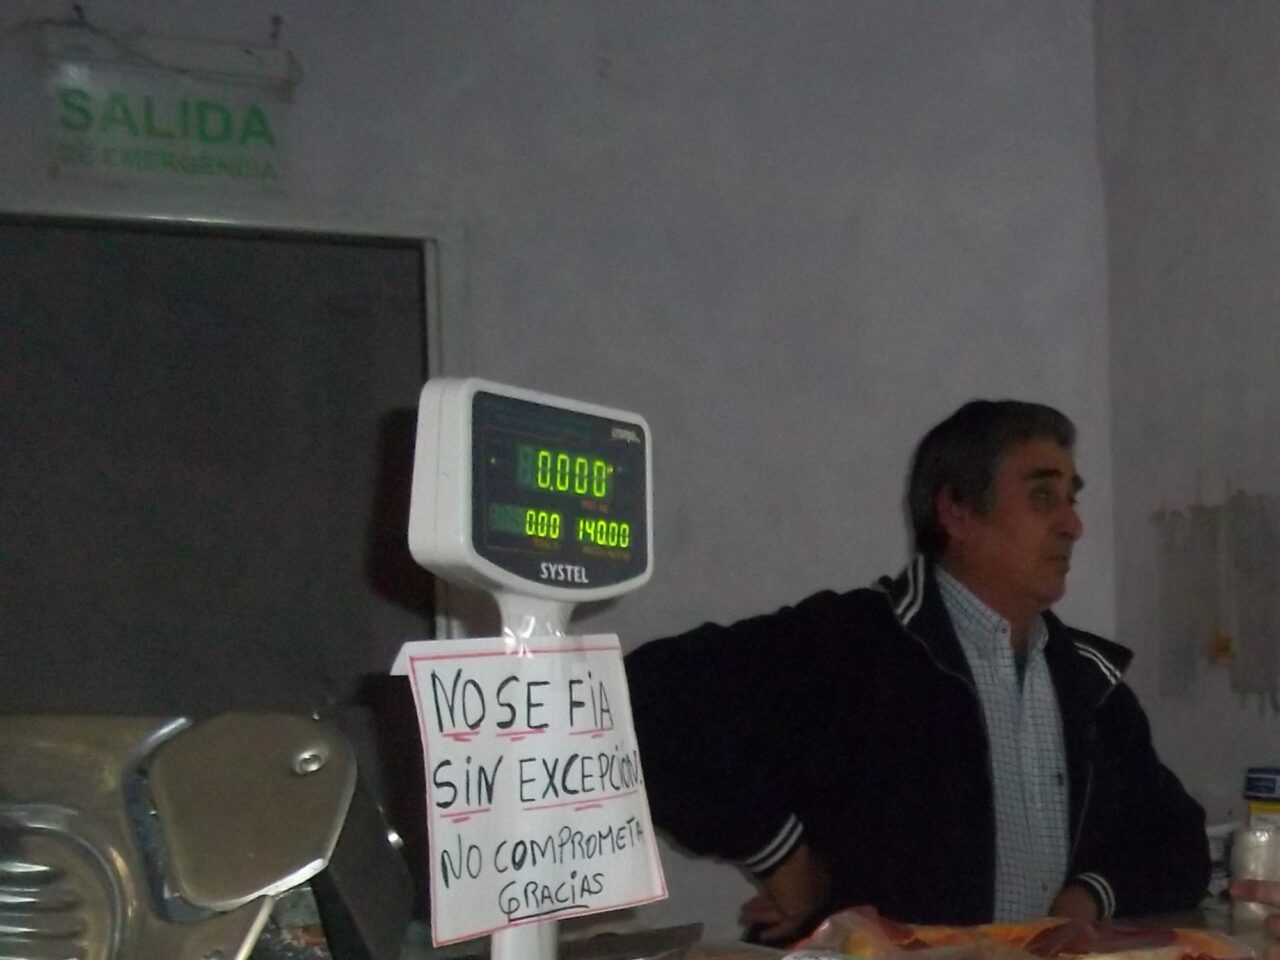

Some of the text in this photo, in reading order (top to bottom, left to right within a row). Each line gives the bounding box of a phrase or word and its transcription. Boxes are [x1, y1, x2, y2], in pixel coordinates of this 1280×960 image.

[59, 88, 276, 148] SALIDA
[537, 450, 606, 498] 0.000
[525, 510, 630, 548] 0.00 140.00
[540, 562, 589, 583] SYSTEL
[431, 668, 486, 733] NO
[496, 675, 550, 730] SE
[441, 816, 646, 889] NO COMPROMETA
